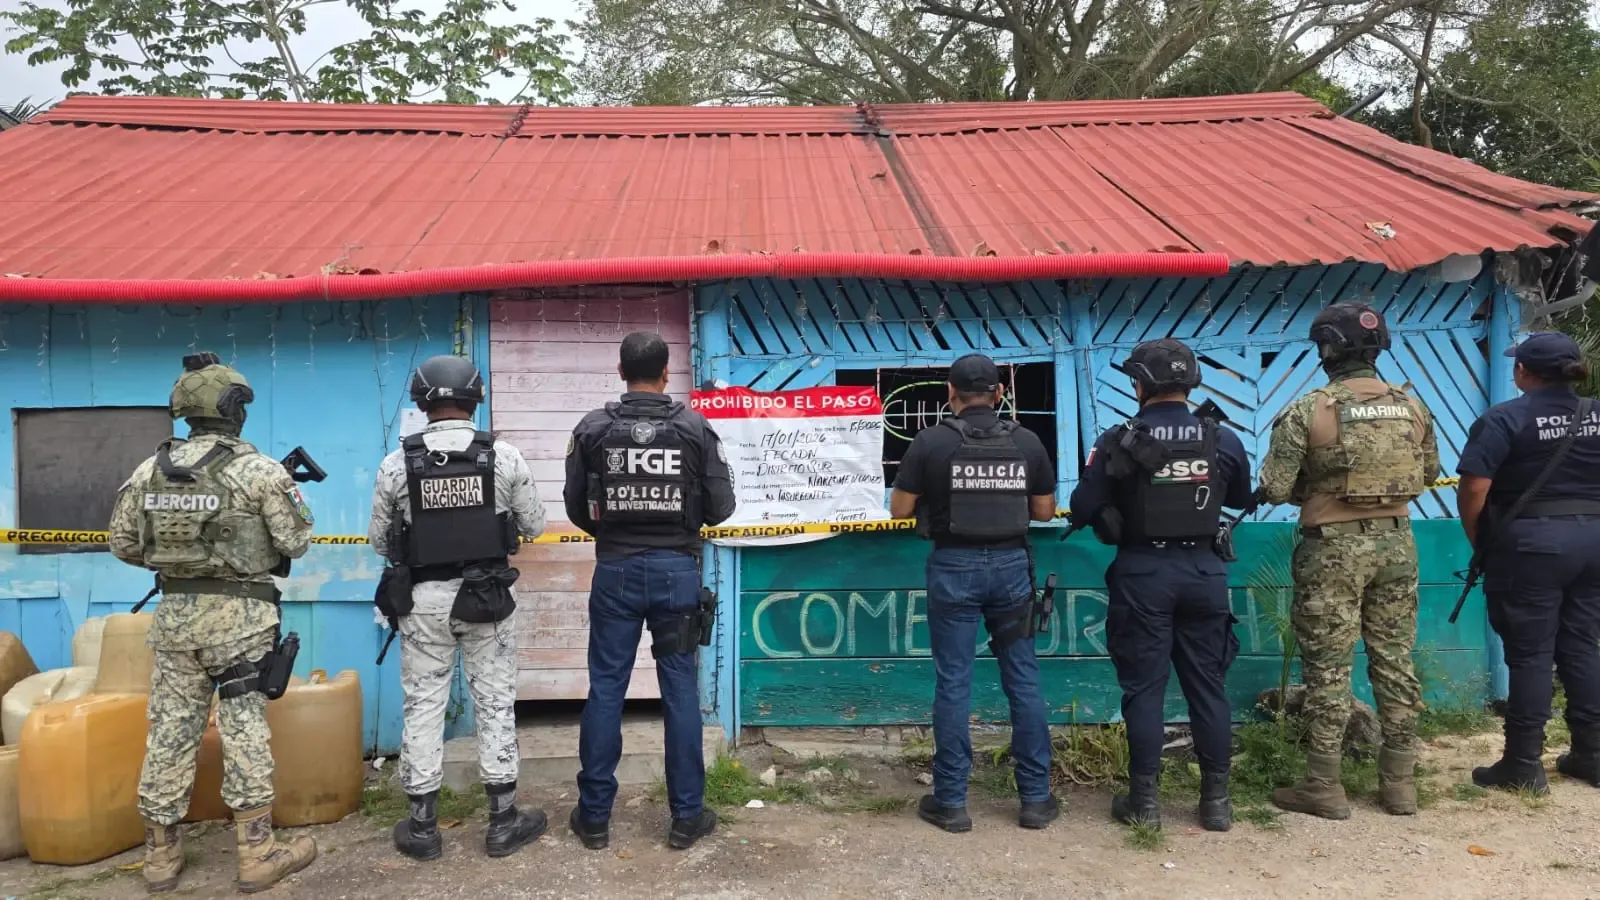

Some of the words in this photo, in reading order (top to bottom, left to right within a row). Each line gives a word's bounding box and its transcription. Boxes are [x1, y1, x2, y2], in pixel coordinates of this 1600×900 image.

[690, 396, 787, 409] PROHIBIDO
[794, 396, 815, 408] EL
[822, 395, 871, 409] PASO
[1350, 405, 1411, 418] MARINA
[628, 448, 681, 475] FGE
[952, 463, 1026, 478] POLICÍA
[422, 478, 481, 494] GUARDIA
[952, 479, 964, 489] DE
[965, 477, 1026, 489] INVESTIGACIÓN
[423, 490, 482, 508] NACIONAL
[606, 485, 682, 500] POLICÍA
[144, 493, 220, 510] EJERCITO
[606, 500, 617, 511] DE
[618, 499, 682, 512] INVESTIGACIÓN
[830, 511, 914, 533] PRECAUCI
[7, 531, 110, 543] PRECAUCIO
[752, 589, 1114, 657] COMEOR
